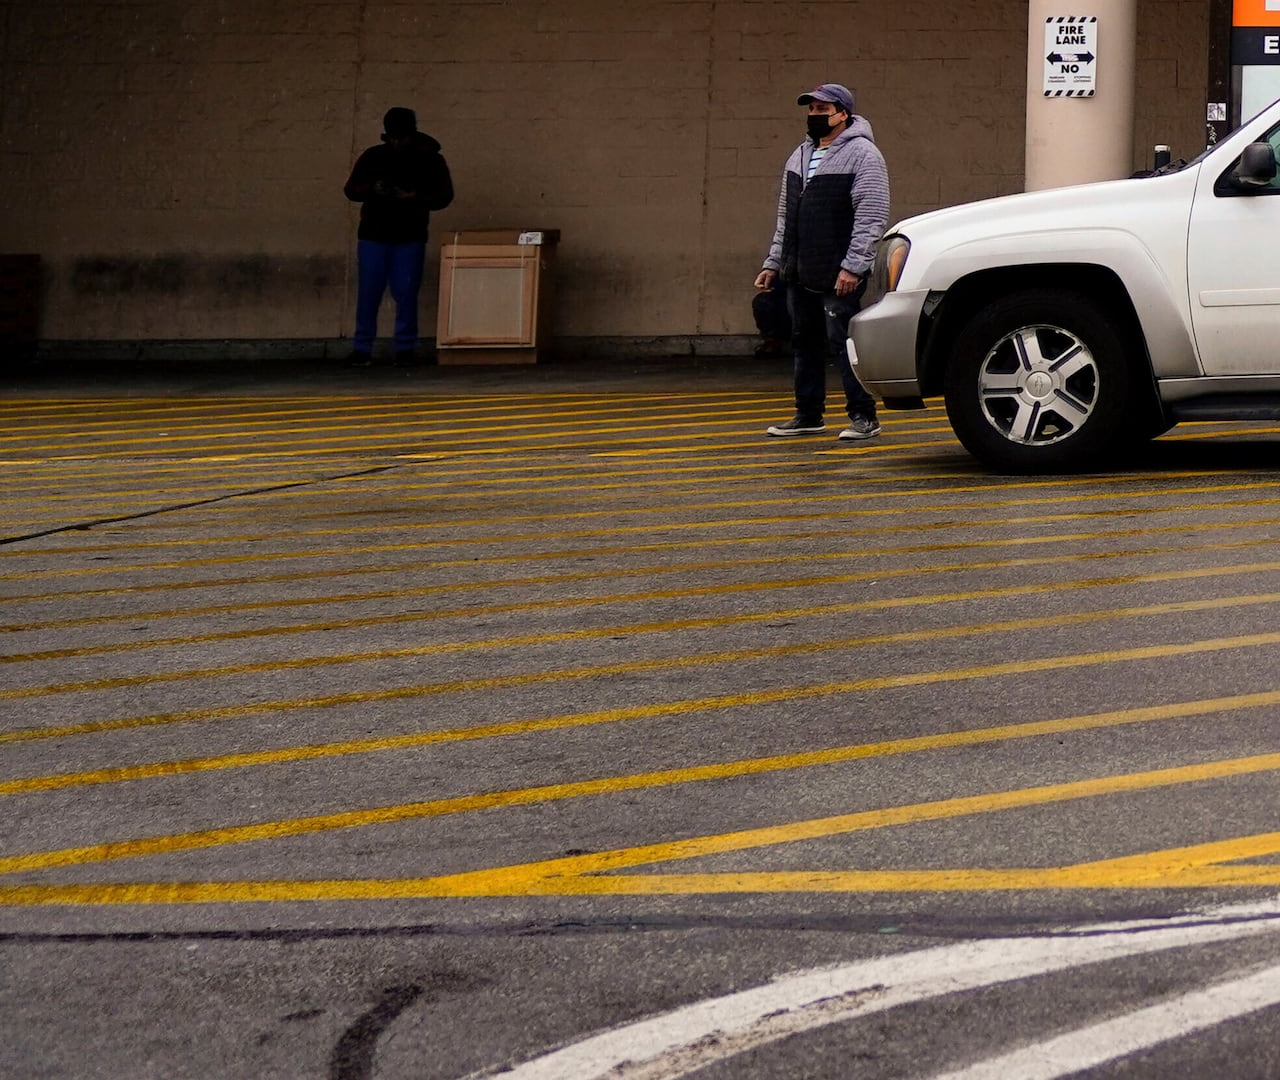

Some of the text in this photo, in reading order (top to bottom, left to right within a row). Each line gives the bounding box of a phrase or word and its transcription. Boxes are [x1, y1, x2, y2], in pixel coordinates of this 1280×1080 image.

[1059, 26, 1084, 34] FIRE
[1056, 36, 1086, 45] LANE
[1061, 64, 1080, 73] NO
